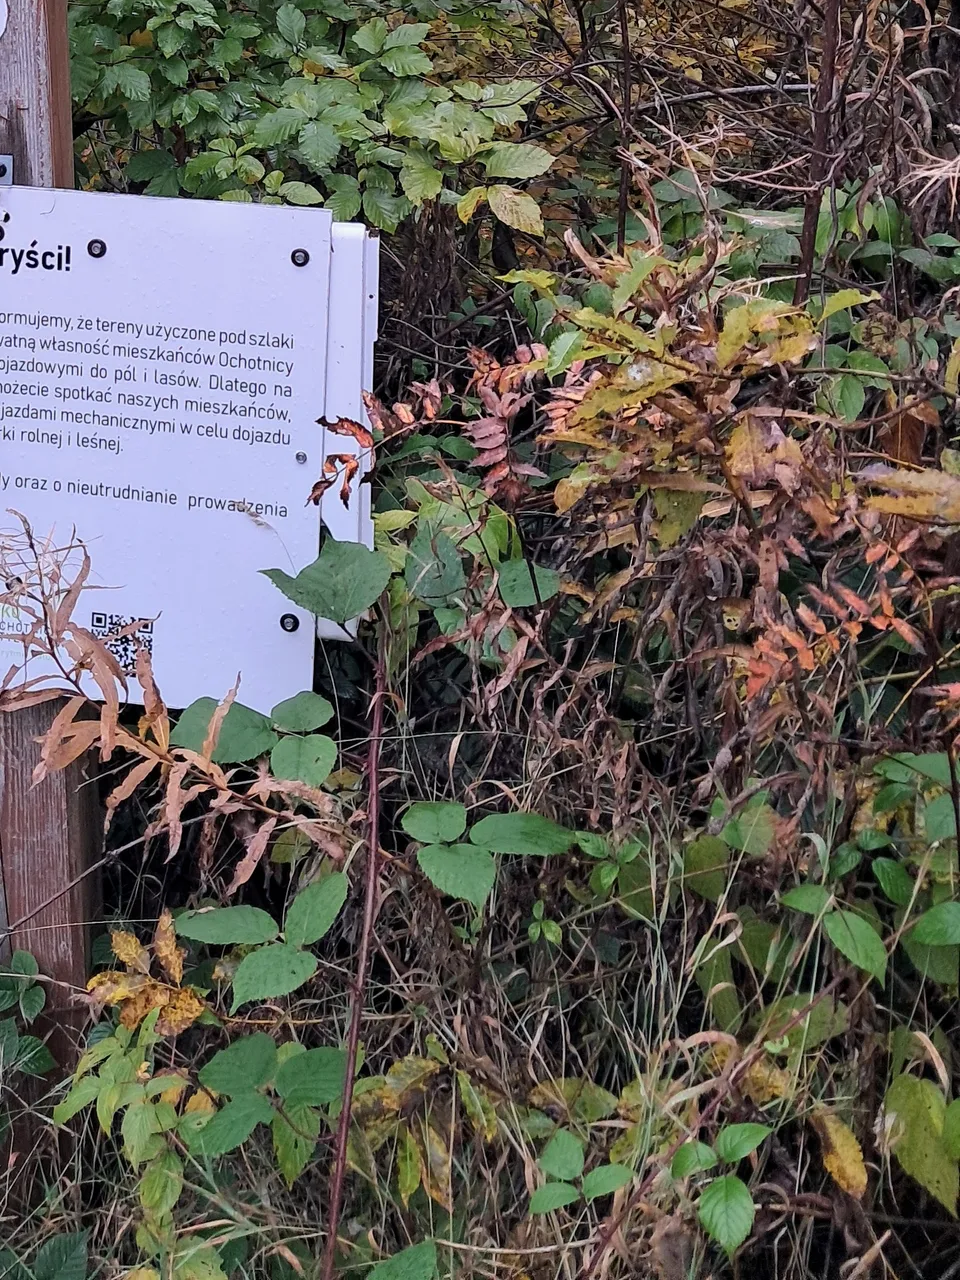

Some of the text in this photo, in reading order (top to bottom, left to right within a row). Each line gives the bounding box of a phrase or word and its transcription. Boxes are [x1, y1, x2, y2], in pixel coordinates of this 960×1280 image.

[77, 314, 92, 331] że
[96, 318, 143, 338] tereny
[146, 323, 215, 342] użyczone
[220, 328, 246, 346] pod
[249, 332, 294, 349] szlaki
[40, 336, 109, 355] własność
[113, 343, 215, 365] mieszkańców
[219, 352, 293, 377] Ochotnicy
[91, 363, 107, 378] do
[115, 365, 136, 384] pól
[155, 370, 201, 388] lasów.
[210, 375, 266, 397] Dlatego
[274, 385, 291, 397] na
[55, 385, 112, 404] spotkać
[118, 391, 178, 411] naszych
[185, 398, 291, 423] mieszkańców,
[21, 428, 62, 449] rolnej
[77, 432, 123, 455] leśnej.
[61, 408, 175, 434] mechanicznymi
[180, 423, 192, 434] w
[197, 420, 228, 437] celu
[233, 424, 290, 445] dojazdu
[15, 477, 47, 490] oraz
[54, 481, 61, 491] o
[68, 479, 177, 505] nieutrudnianie
[188, 494, 288, 518] prowadzenia
